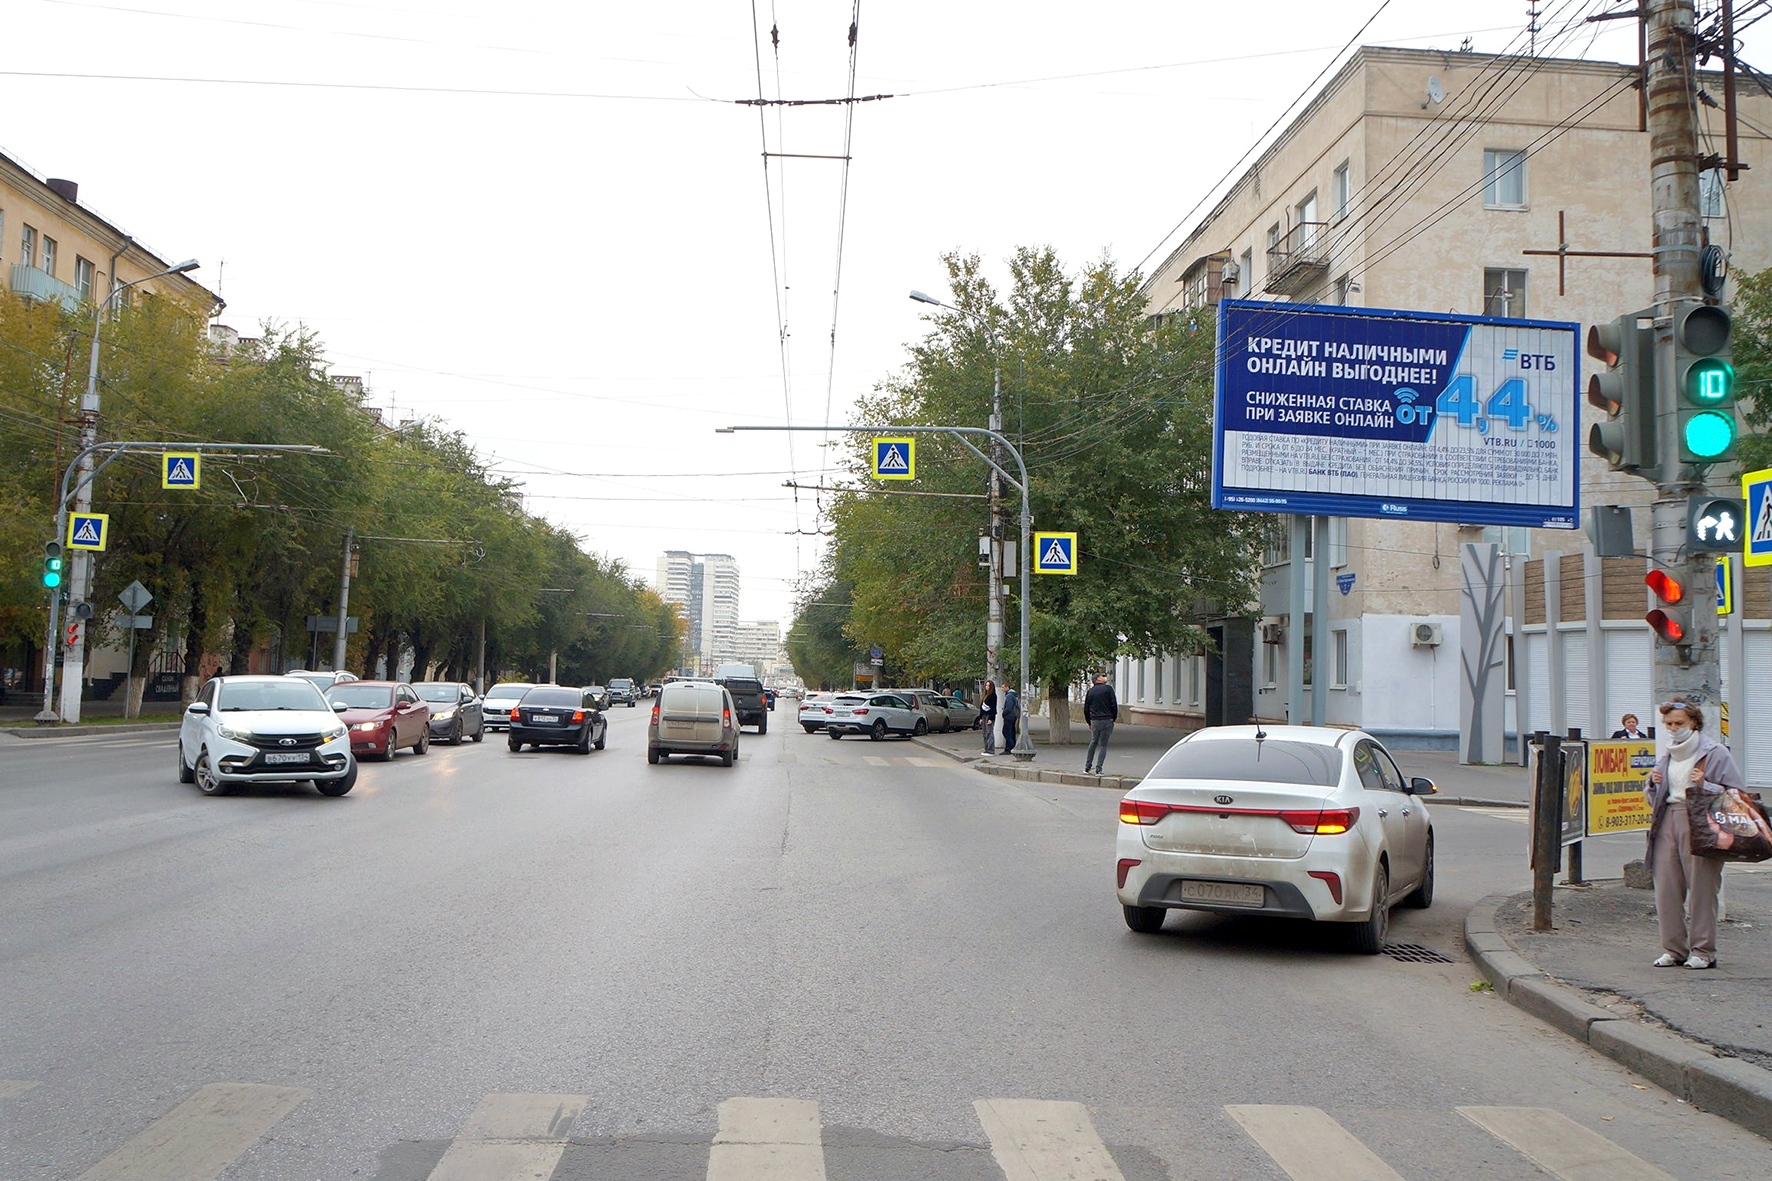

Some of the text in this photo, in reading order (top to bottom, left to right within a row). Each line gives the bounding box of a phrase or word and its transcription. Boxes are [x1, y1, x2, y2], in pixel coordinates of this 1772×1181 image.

[1248, 337, 1447, 365] КРЕДИТ НАЛИЧНЫМИ
[1520, 353, 1556, 371] ВТБ
[1247, 355, 1437, 385] ОНЛАЙН ВЫГОДНЕЕ!
[1700, 370, 1724, 398] 10
[1246, 391, 1391, 412] СНИЖЕННАЯ СТАВКА
[1246, 407, 1394, 428] ПРИ ЗАЯВКЕ ОНЛАЙН
[1483, 437, 1517, 447] VTB.RU
[1594, 748, 1628, 777] ЛОМБАРД
